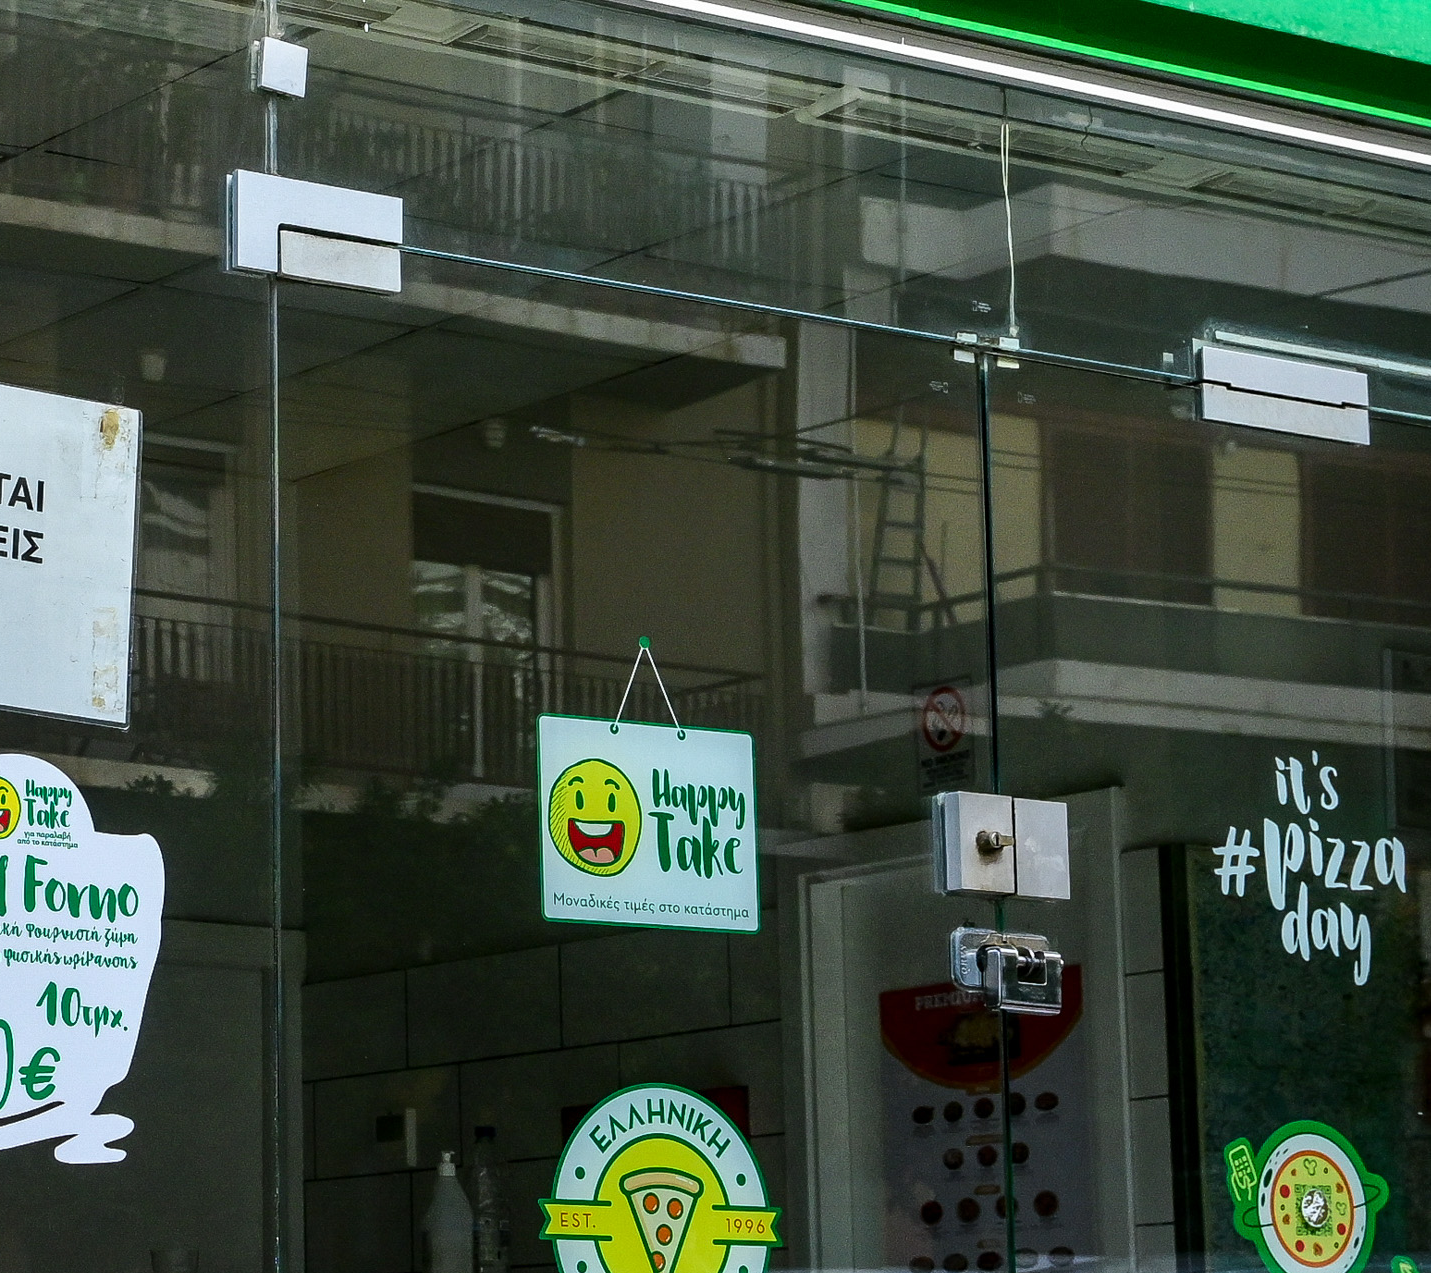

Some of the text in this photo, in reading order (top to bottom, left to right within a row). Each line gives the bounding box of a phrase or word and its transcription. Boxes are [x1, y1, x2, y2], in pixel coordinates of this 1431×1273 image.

[25, 779, 73, 807] Happy
[652, 768, 745, 830] Happy
[1275, 749, 1339, 815] it's
[23, 798, 71, 829] Take
[647, 810, 744, 879] Take
[23, 854, 139, 923] Forno
[553, 891, 750, 920] Μοναδικές τιμές στο κατάστημα
[104, 926, 139, 948] ζύμη
[1281, 881, 1372, 986] day
[588, 1098, 731, 1158] ΕΛΛΗΝΙΚΗ
[560, 1212, 766, 1234] EST. 1996
